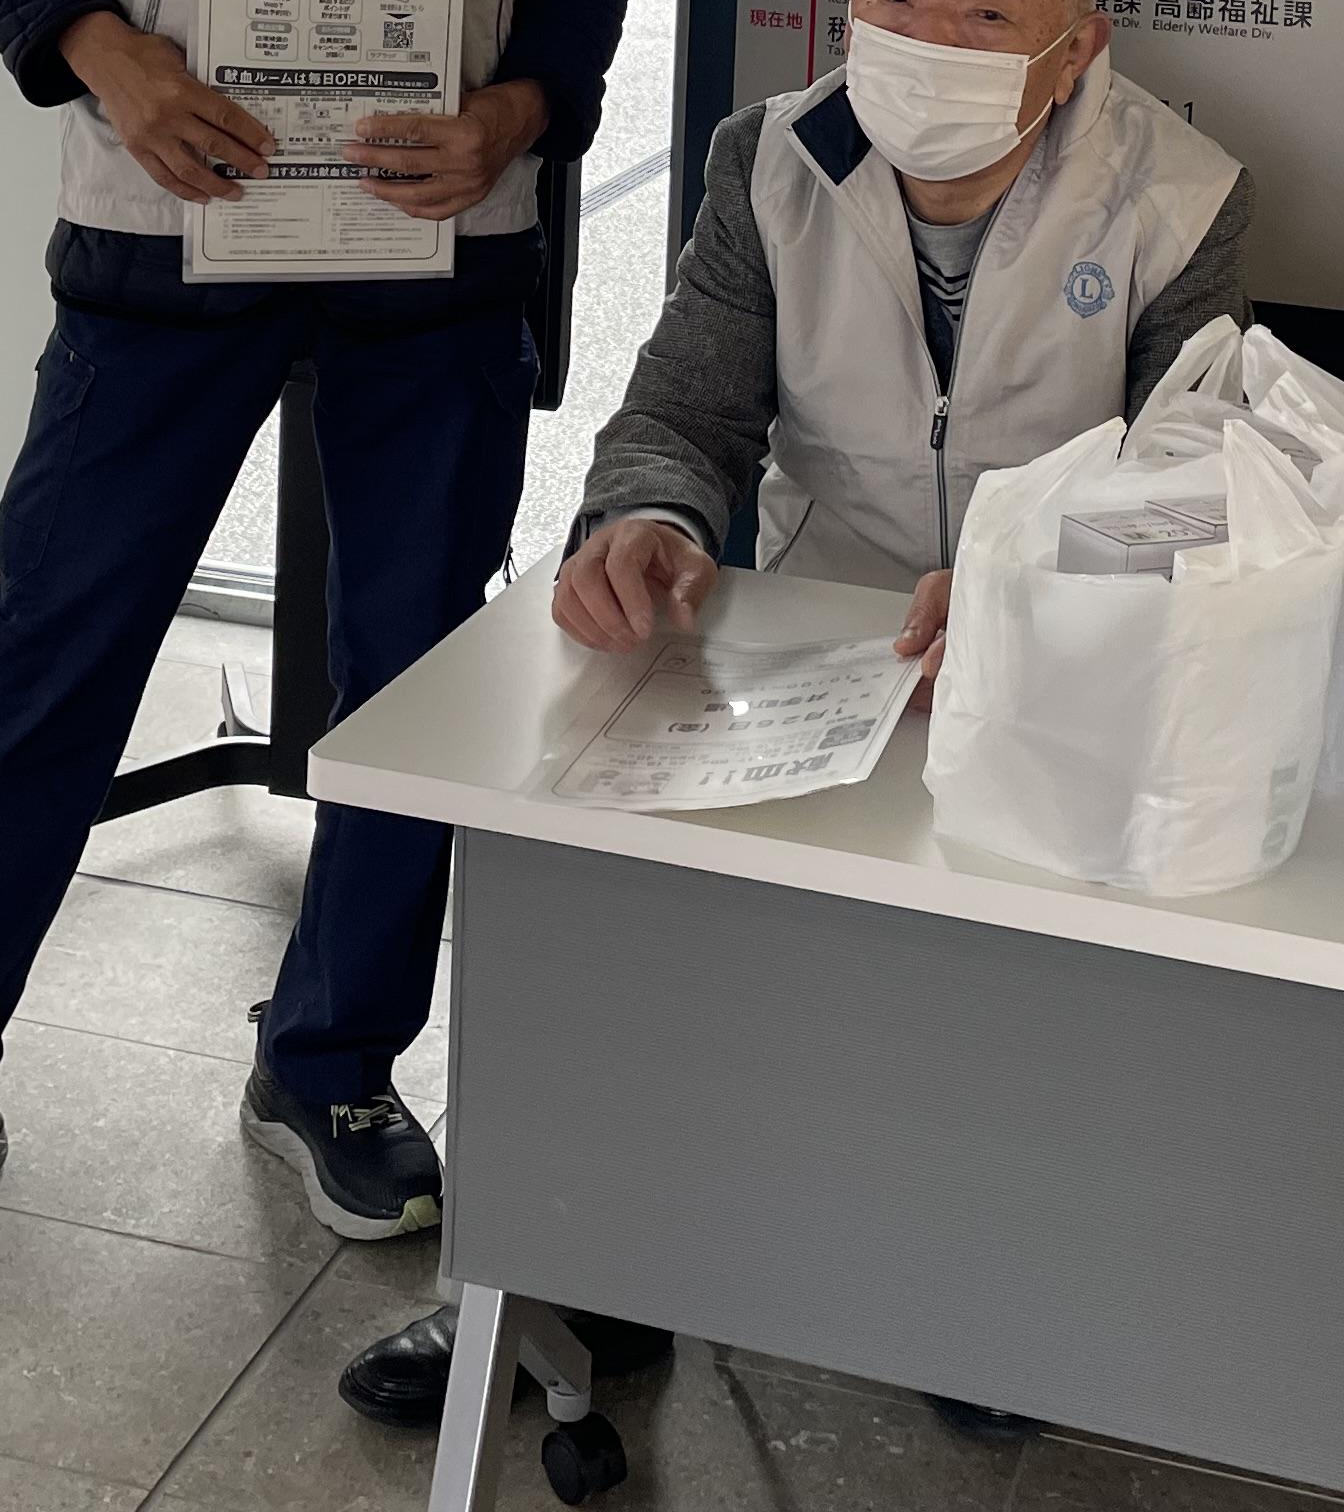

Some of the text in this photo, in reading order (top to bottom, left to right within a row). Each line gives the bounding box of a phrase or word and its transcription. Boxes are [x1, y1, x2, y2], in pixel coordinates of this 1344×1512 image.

[750, 9, 803, 29] 現在地
[1152, 20, 1195, 35] Elderly
[1198, 24, 1248, 38] Welfare
[1251, 27, 1274, 40] Div.
[1080, 278, 1094, 299] L
